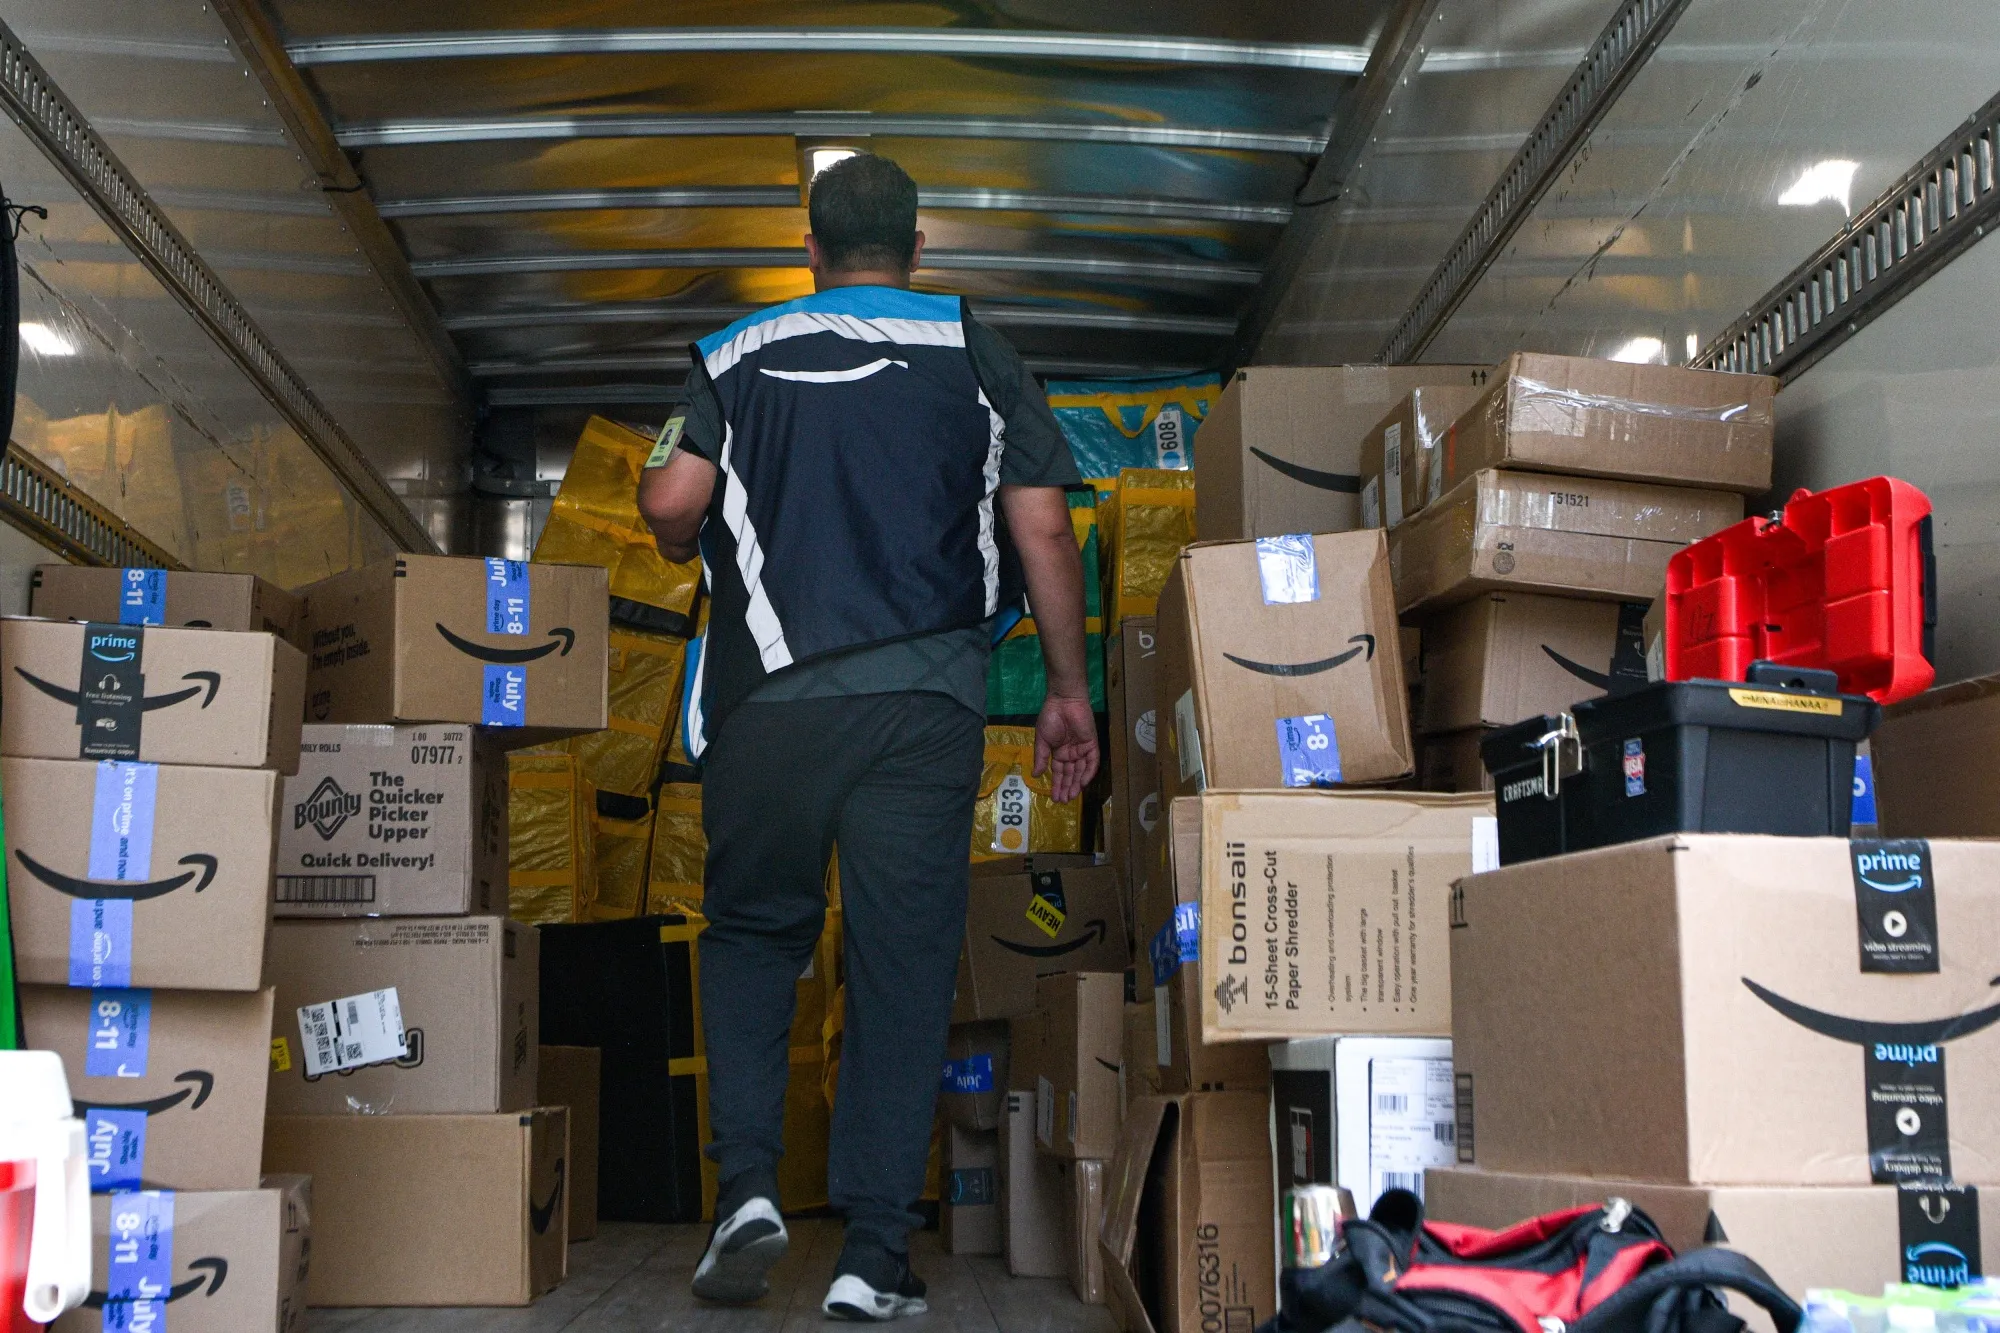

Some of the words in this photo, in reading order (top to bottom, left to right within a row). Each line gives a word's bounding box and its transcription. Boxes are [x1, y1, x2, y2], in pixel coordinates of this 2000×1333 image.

[1158, 421, 1178, 451] 608
[489, 557, 507, 587] Jul
[126, 569, 145, 606] 8-11
[507, 598, 524, 634] 8-11
[91, 634, 137, 649] prime
[503, 670, 522, 711] July
[301, 743, 317, 753] MILY
[319, 743, 341, 753] ROLLS
[443, 732, 463, 741] 30772
[1286, 726, 1297, 752] prime
[411, 746, 455, 764] 07977
[457, 756, 463, 764] 2
[369, 771, 404, 787] The
[1503, 775, 1544, 803] CRAFTSMA
[123, 787, 134, 800] on
[369, 789, 444, 806] Quicker
[1001, 788, 1023, 826] 853
[120, 802, 135, 835] prime
[294, 792, 361, 830] Bounty
[369, 806, 429, 822] Picker
[368, 823, 428, 843] Upper
[119, 837, 129, 858] and
[300, 853, 352, 868] Quick
[356, 853, 435, 871] Delivery!
[1325, 854, 1335, 892] protection
[1857, 850, 1921, 875] prime
[1227, 841, 1248, 965] bonsaii
[1264, 850, 1278, 934] Cross-Cut
[93, 908, 104, 929] and
[1029, 901, 1061, 932] HEAVY
[1285, 881, 1299, 958] Shredder
[1326, 893, 1336, 938] overloading
[91, 931, 105, 965] prime
[1327, 939, 1335, 954] and
[1359, 929, 1367, 944] with
[1408, 933, 1417, 966] warranty
[1864, 941, 1887, 952] video
[1887, 942, 1932, 954] streaming
[1264, 935, 1279, 1010] 15-Sheet
[1359, 946, 1368, 972] basket
[1392, 946, 1401, 982] operation
[92, 966, 102, 981] on
[1286, 960, 1302, 1010] Paper
[1327, 956, 1337, 1003] Overheating
[1376, 959, 1385, 1003] transparent
[1410, 967, 1418, 985] year
[1344, 975, 1353, 1003] system
[1360, 988, 1368, 1003] The
[1393, 983, 1402, 1003] Easy
[95, 1000, 122, 1049] 8-11
[1875, 1043, 1937, 1068] prime
[1871, 1091, 1918, 1105] streaming
[1918, 1094, 1944, 1105] video
[87, 1119, 119, 1175] July
[1884, 1163, 1922, 1176] delivery
[1922, 1165, 1944, 1176] free
[114, 1212, 140, 1264] 8-11
[1197, 1223, 1222, 1333] 0076316
[1907, 1263, 1969, 1290] prime
